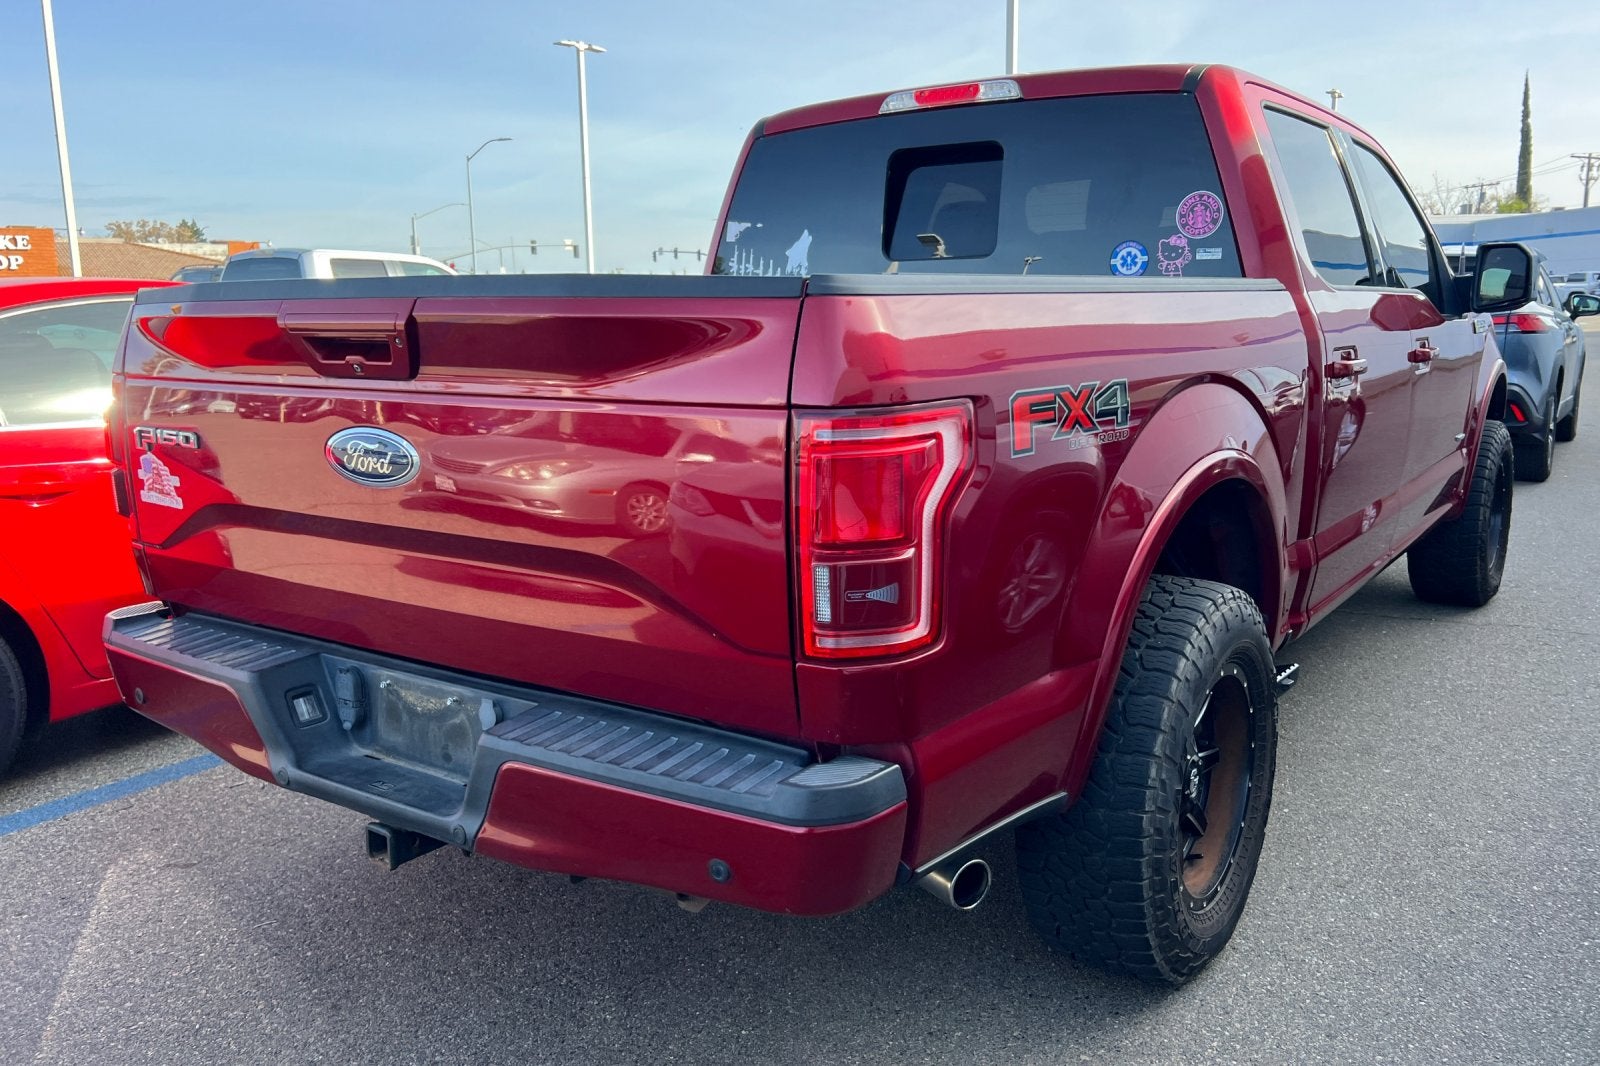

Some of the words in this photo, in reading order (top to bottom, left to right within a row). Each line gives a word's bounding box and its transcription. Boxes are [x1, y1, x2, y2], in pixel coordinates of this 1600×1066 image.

[1180, 195, 1200, 215] GUNS
[1202, 195, 1219, 211] AND
[1185, 222, 1215, 235] COFFEE
[1009, 378, 1130, 458] FX4
[1097, 428, 1130, 445] ROAD
[343, 440, 392, 474] Ford
